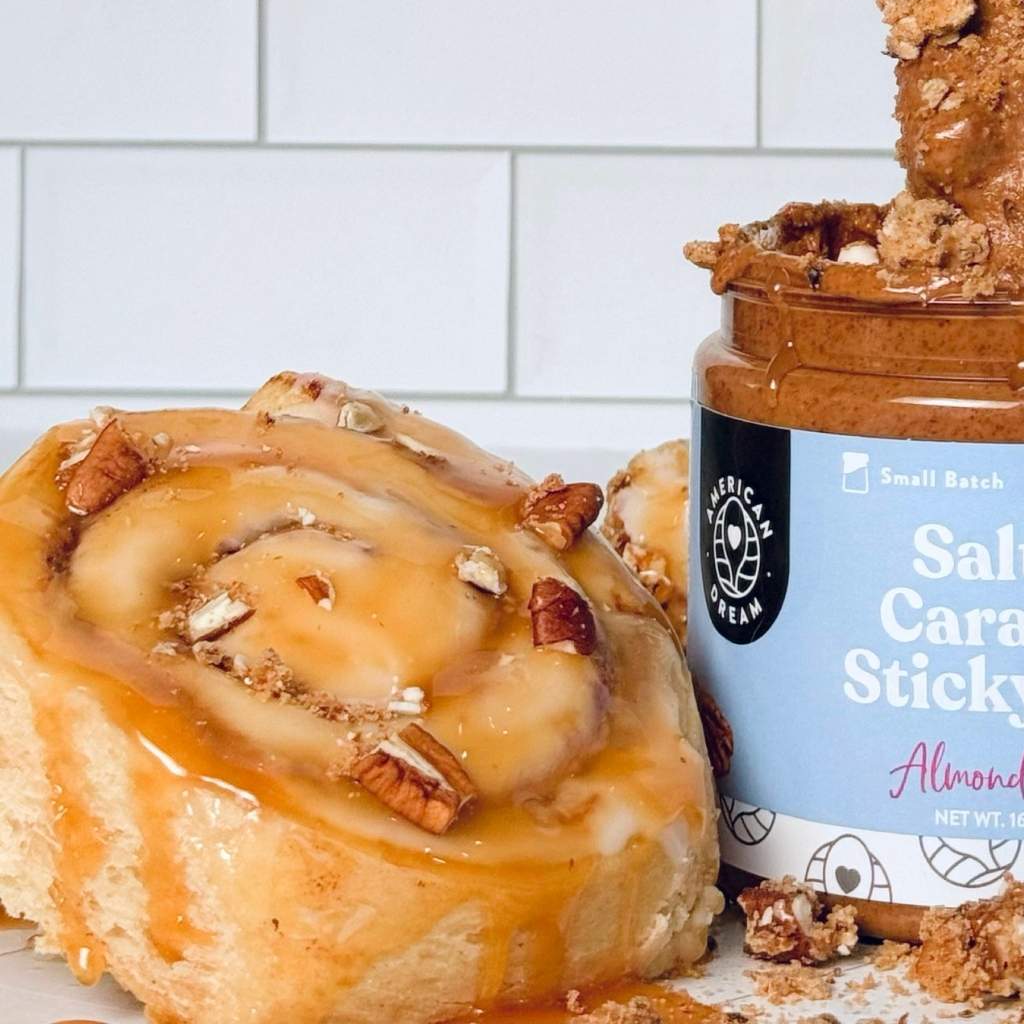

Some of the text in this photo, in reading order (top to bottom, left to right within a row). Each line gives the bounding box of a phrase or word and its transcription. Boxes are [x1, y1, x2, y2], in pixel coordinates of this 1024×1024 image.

[880, 467, 1004, 490] Small Batch
[706, 475, 774, 540] AMERICAN
[710, 583, 763, 625] DREAM
[934, 808, 970, 826] NET
[974, 810, 1006, 829] WT.
